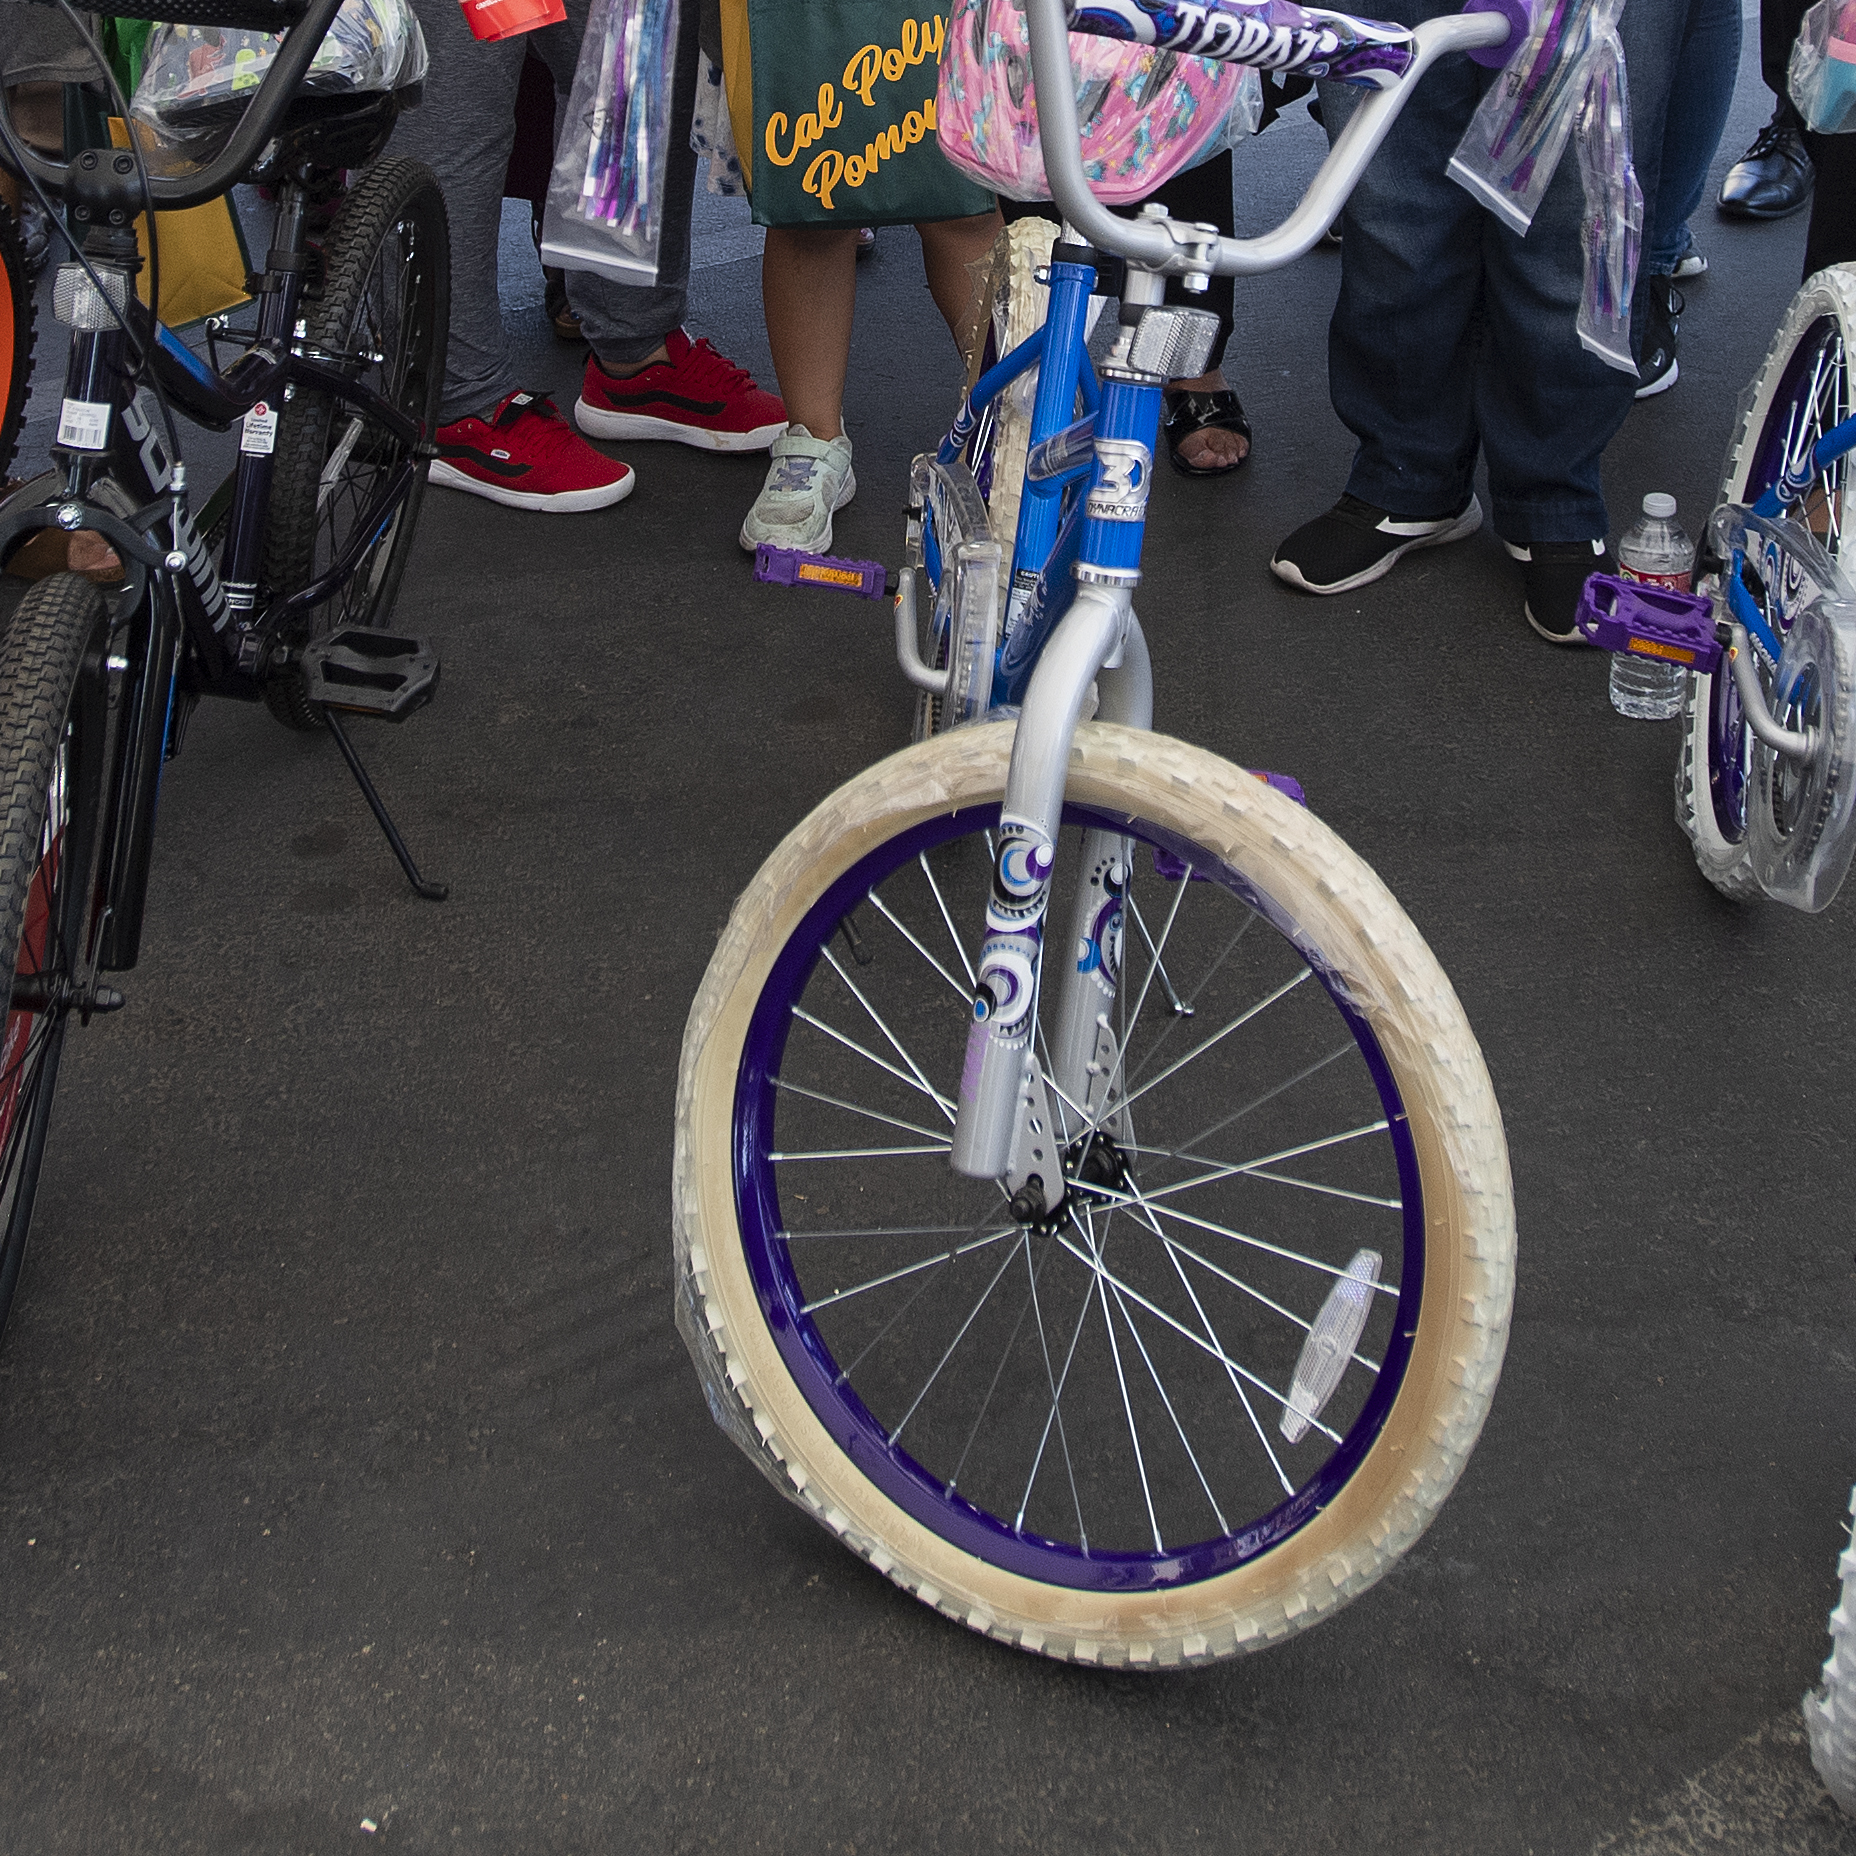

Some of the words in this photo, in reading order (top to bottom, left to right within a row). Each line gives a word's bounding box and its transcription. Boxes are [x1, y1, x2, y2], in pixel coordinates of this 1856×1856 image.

[765, 82, 844, 167] Cal
[841, 14, 949, 107] Poly
[801, 97, 938, 210] Pomon
[1086, 502, 1146, 518] DYNACRA
